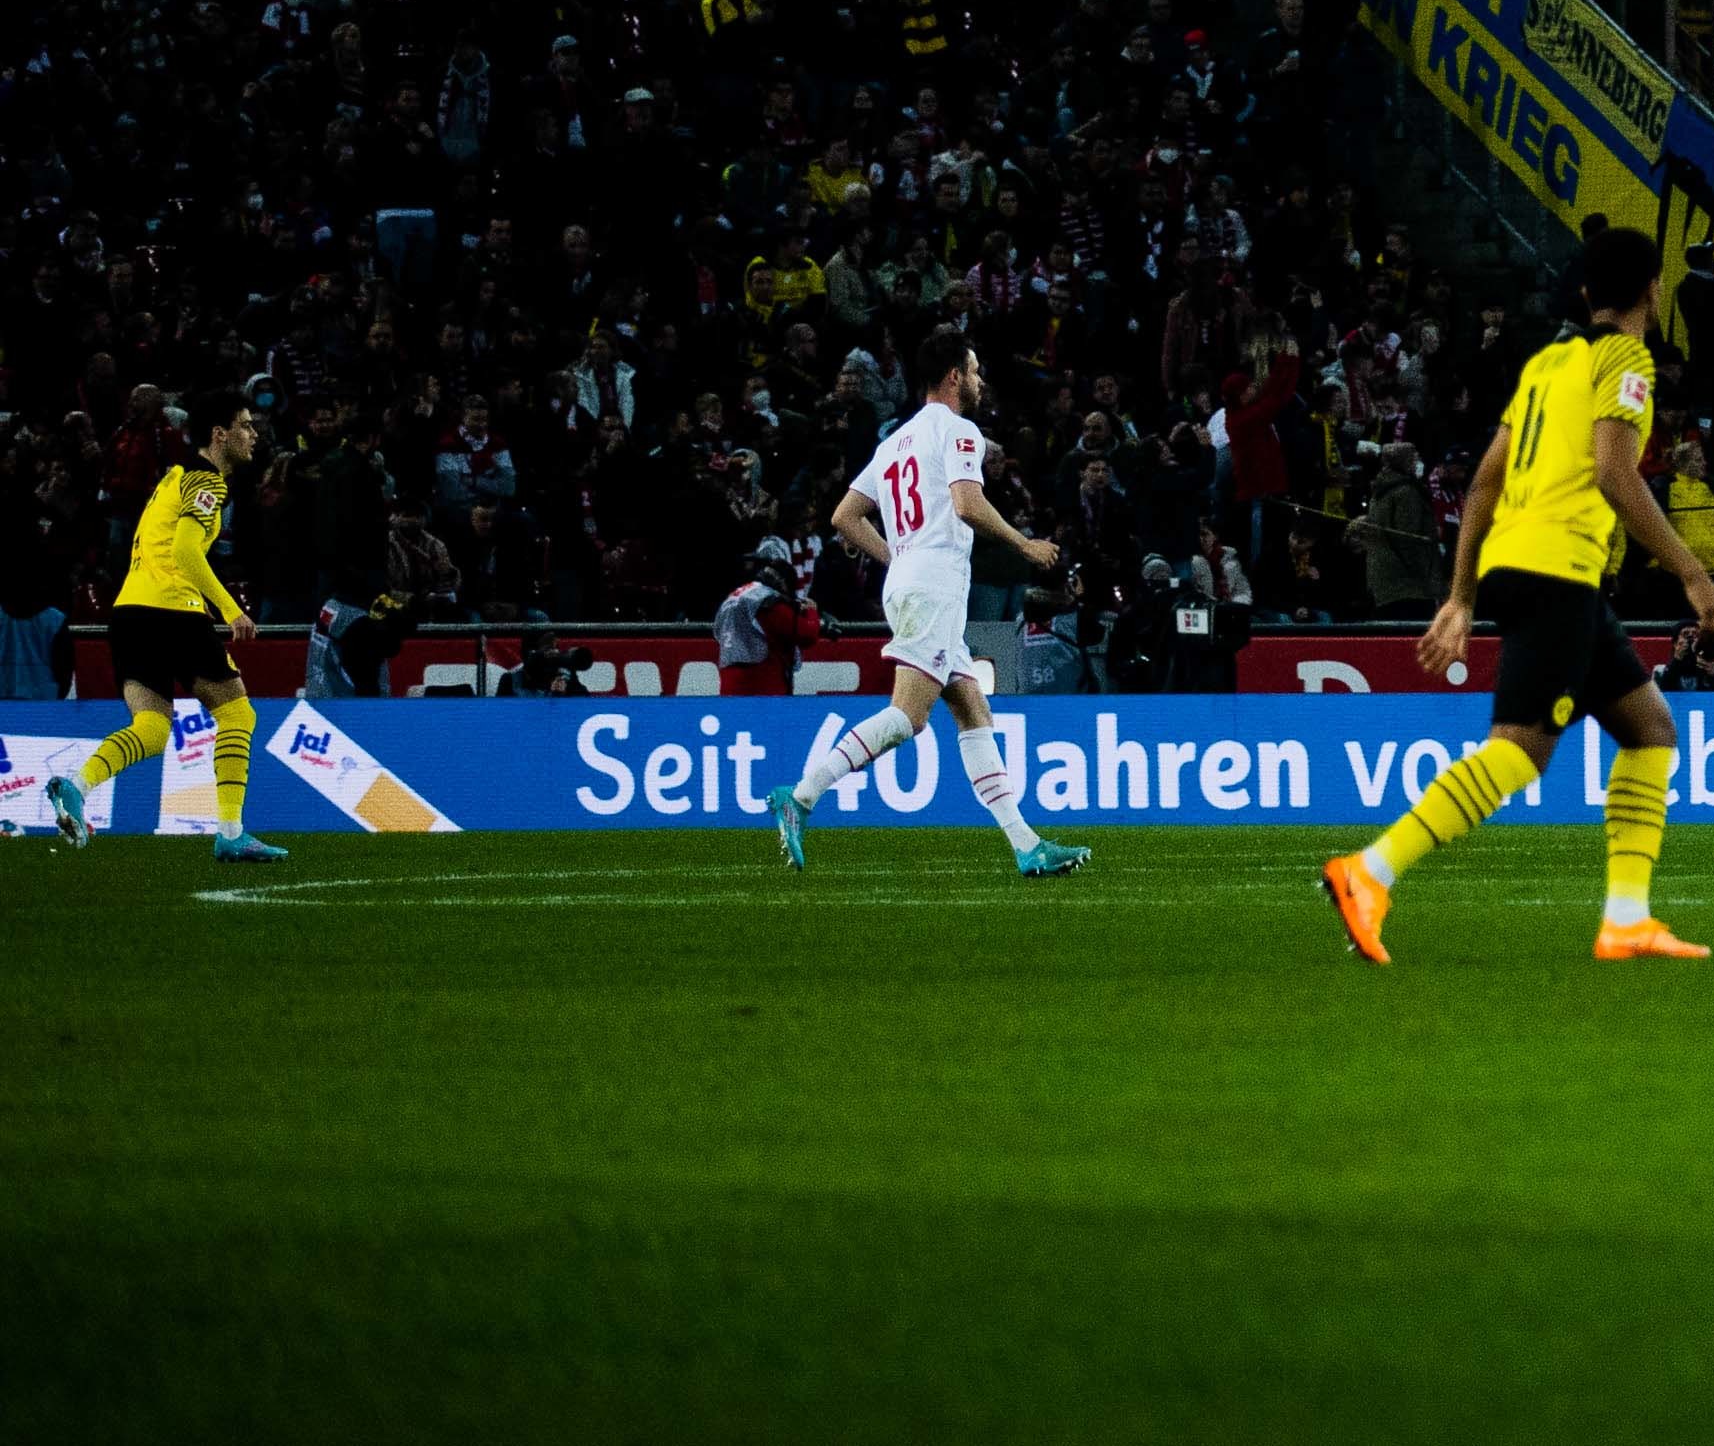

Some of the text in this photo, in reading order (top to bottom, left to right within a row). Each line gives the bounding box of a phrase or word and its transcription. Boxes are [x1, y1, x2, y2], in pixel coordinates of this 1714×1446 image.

[1427, 7, 1581, 204] KRIEG
[1514, 382, 1551, 470] 11
[883, 455, 925, 538] 13
[289, 722, 332, 756] ja!
[576, 713, 772, 816] Seit
